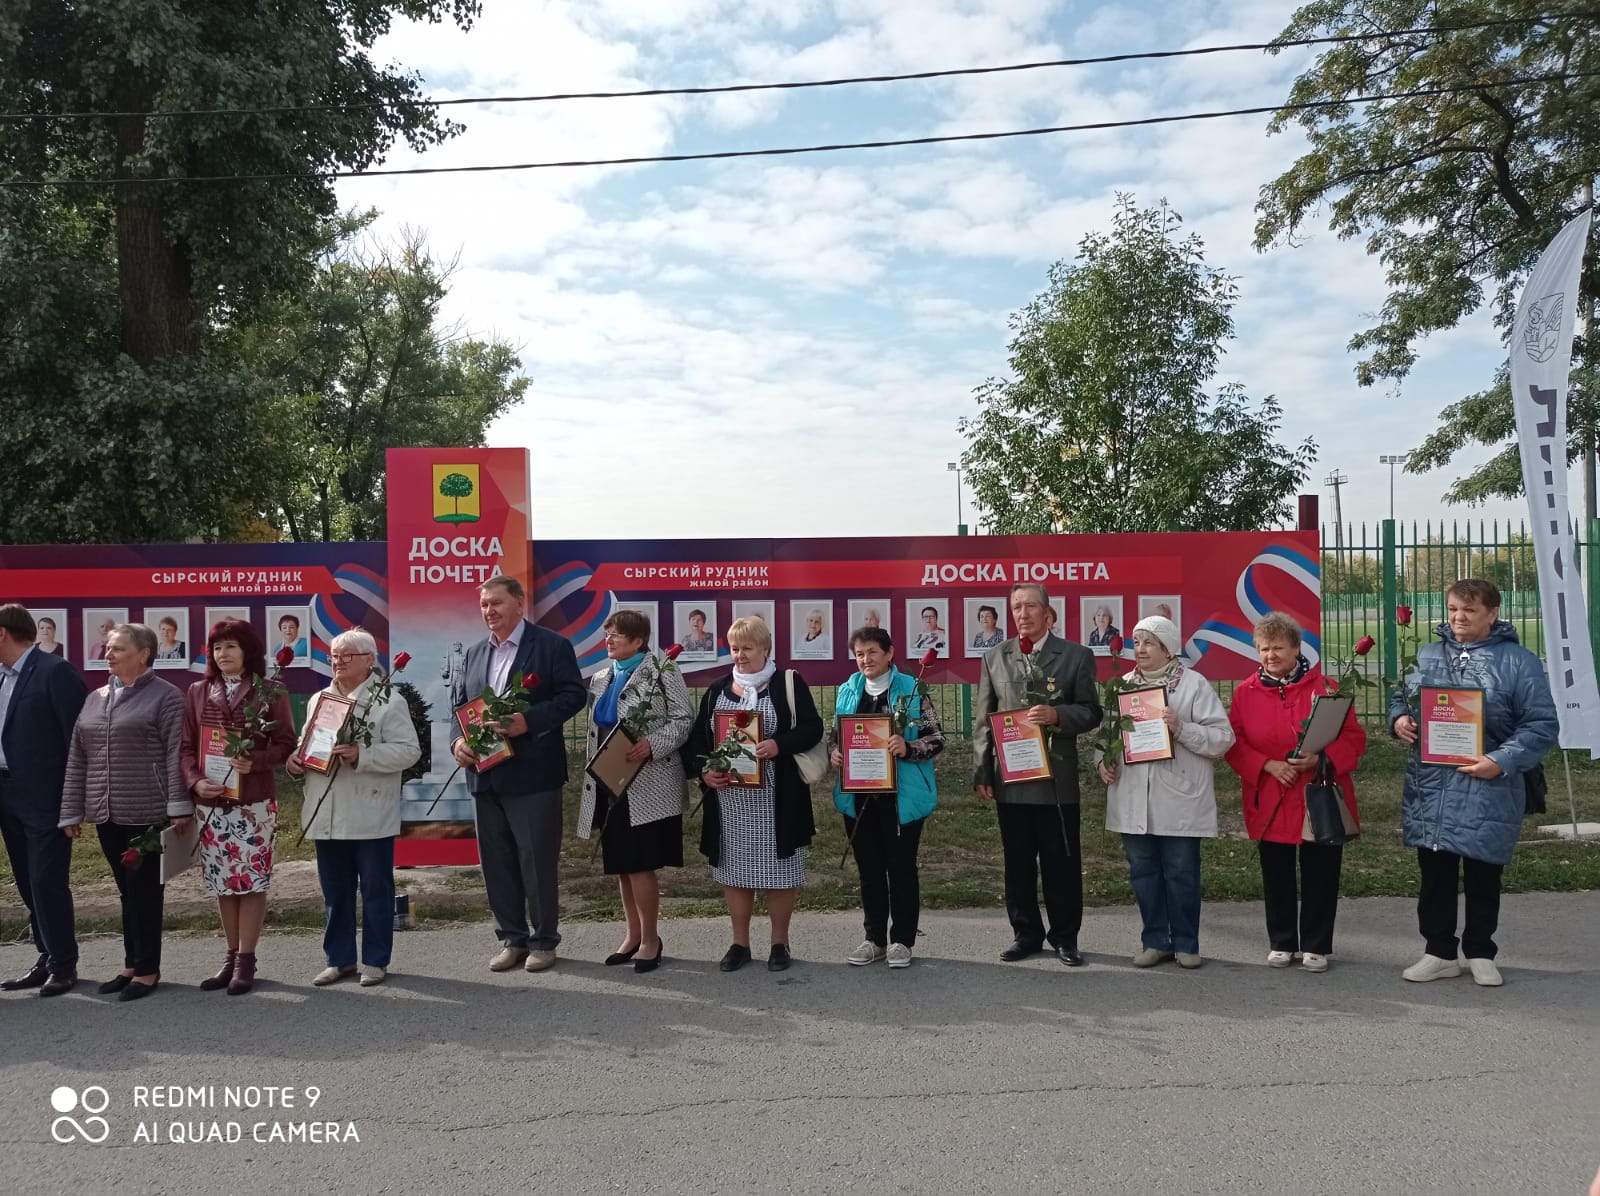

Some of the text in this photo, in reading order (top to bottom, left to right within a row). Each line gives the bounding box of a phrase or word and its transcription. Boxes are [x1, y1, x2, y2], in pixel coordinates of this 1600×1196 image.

[408, 537, 504, 560] ДОСКА
[151, 570, 303, 586] СЫРСКИЙ РУДНИК
[410, 564, 503, 583] ПОЧЕТА
[623, 565, 769, 579] СЫРСКИЙ РУДНИК
[921, 562, 1109, 585] ДОСКА ПОЧЕТА
[220, 583, 303, 594] жилой район
[690, 578, 769, 589] жилой район
